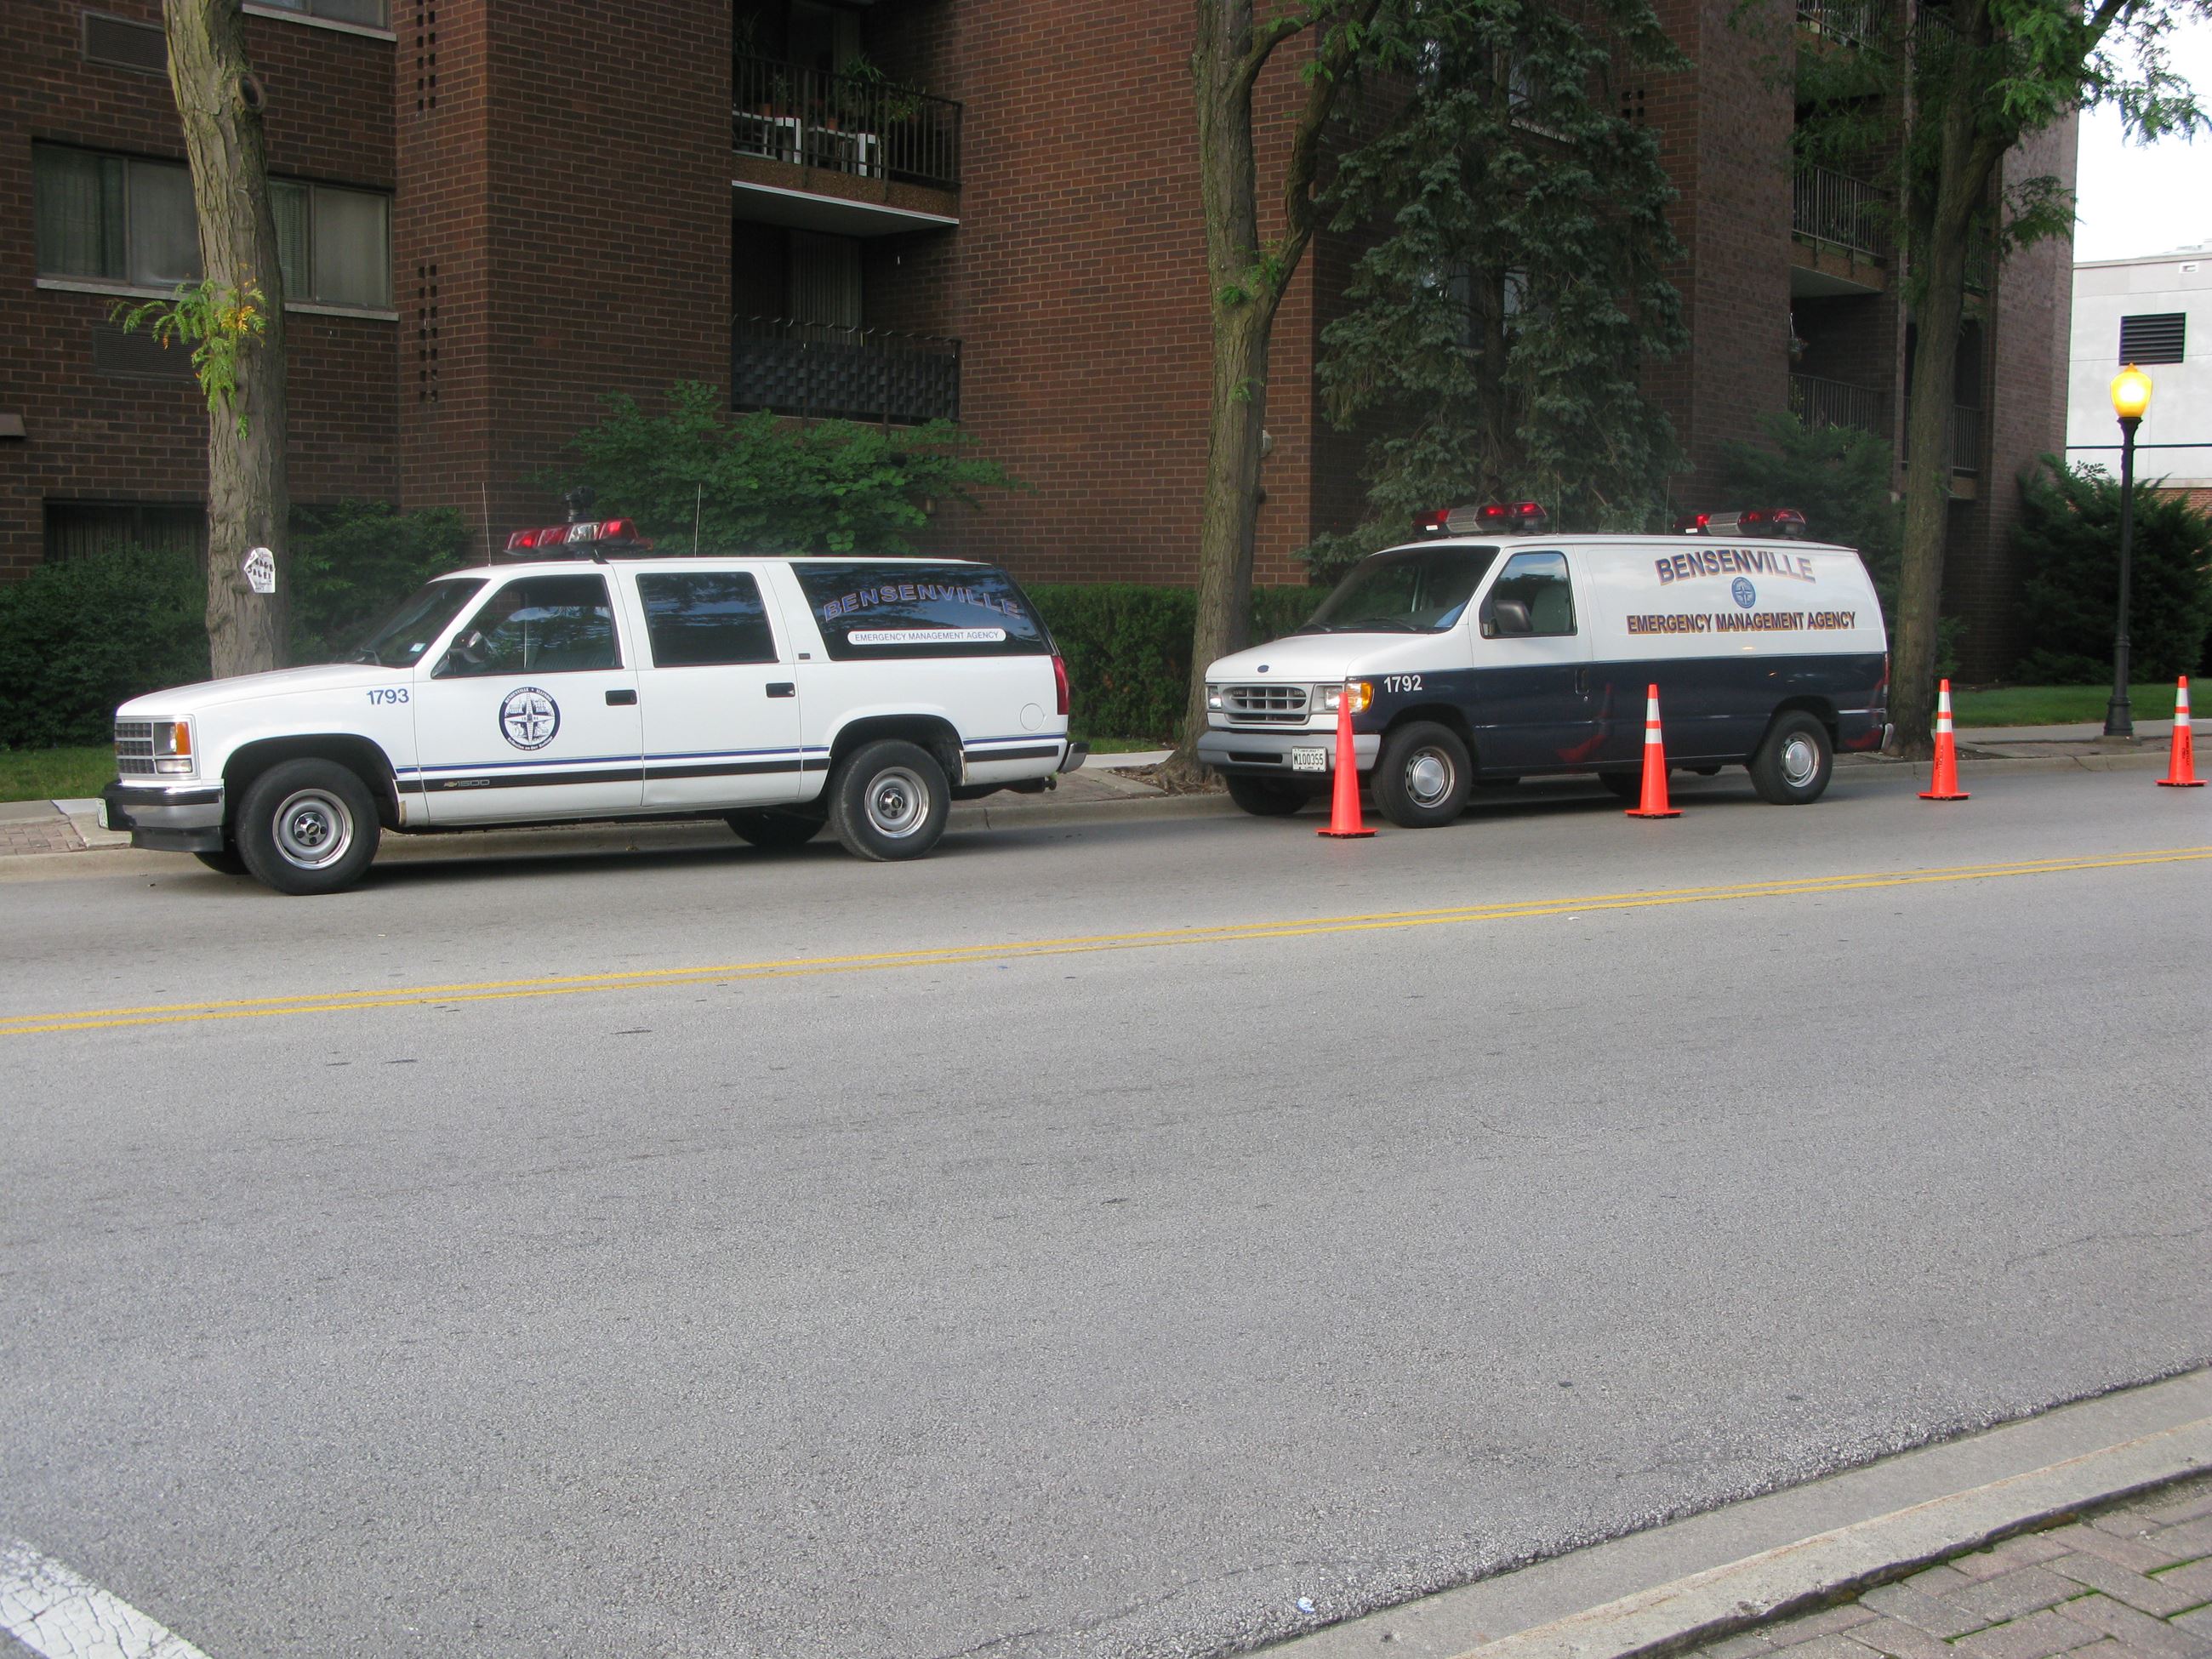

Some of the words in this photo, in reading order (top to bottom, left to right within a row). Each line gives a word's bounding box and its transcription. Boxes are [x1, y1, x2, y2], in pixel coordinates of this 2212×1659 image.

[1655, 549, 1816, 585] BENSENVILLE
[824, 584, 1021, 623] BENSENVILLE
[1627, 613, 1713, 635] EMERGENCY
[1715, 612, 1804, 632] MANAGEMENT
[1807, 611, 1856, 630] AGENCY
[909, 632, 965, 641] MANAGEMENT
[966, 631, 999, 640] AGENCY
[1383, 675, 1422, 693] 1792
[366, 688, 409, 705] 1793
